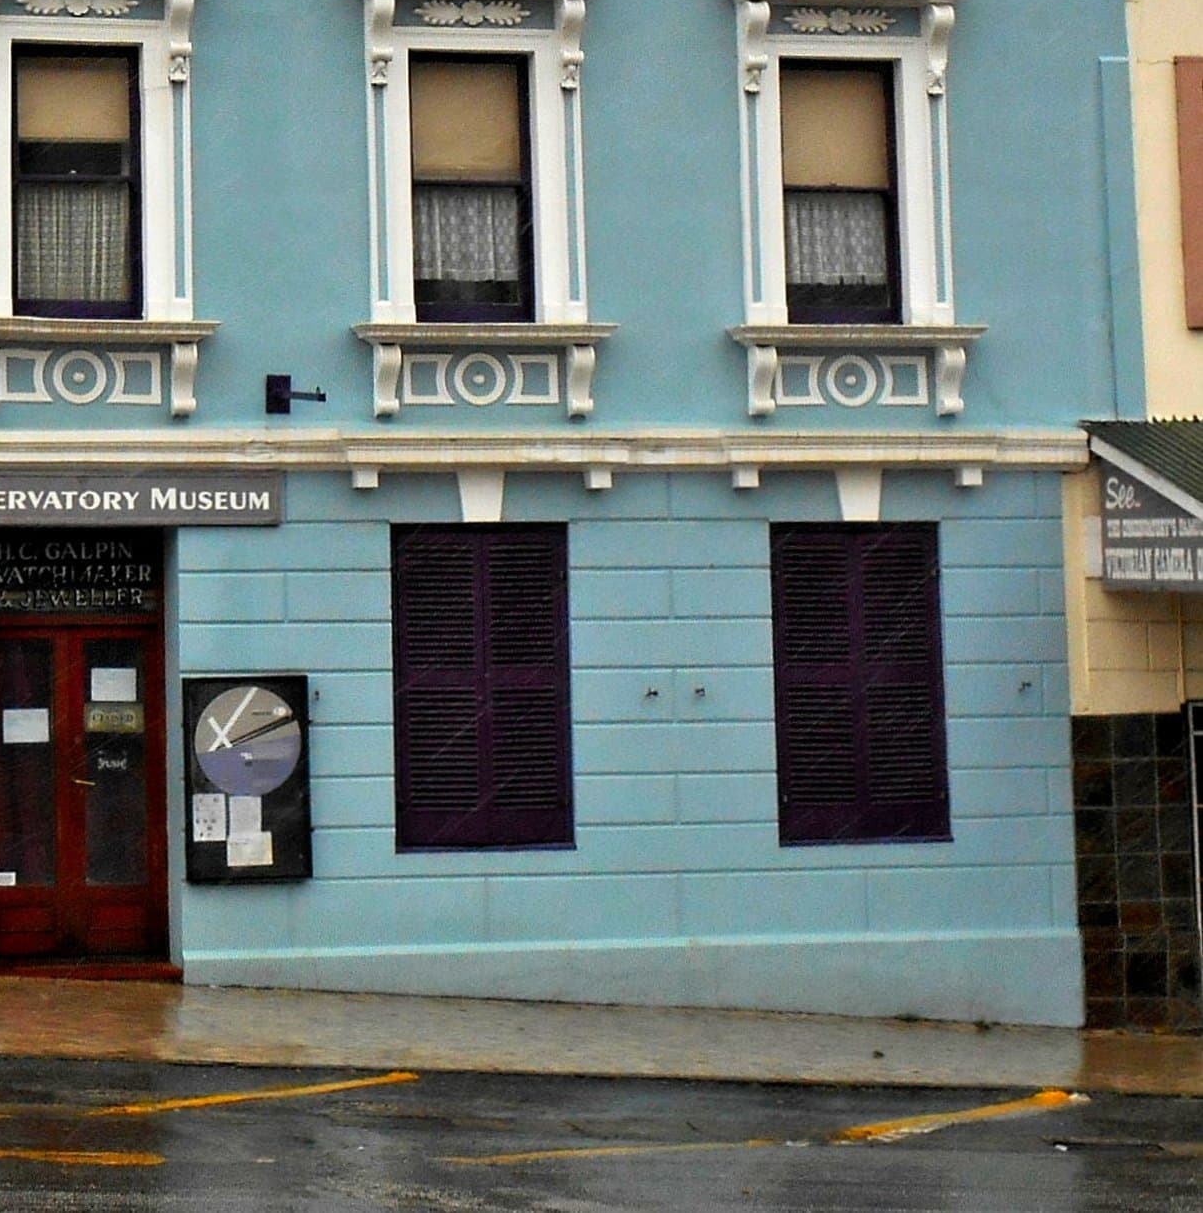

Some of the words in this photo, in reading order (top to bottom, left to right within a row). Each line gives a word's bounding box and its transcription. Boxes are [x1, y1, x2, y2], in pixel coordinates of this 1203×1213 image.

[151, 487, 270, 511] MUSEUM
[45, 542, 132, 560] GALPIN
[21, 588, 142, 606] JEWELLER
